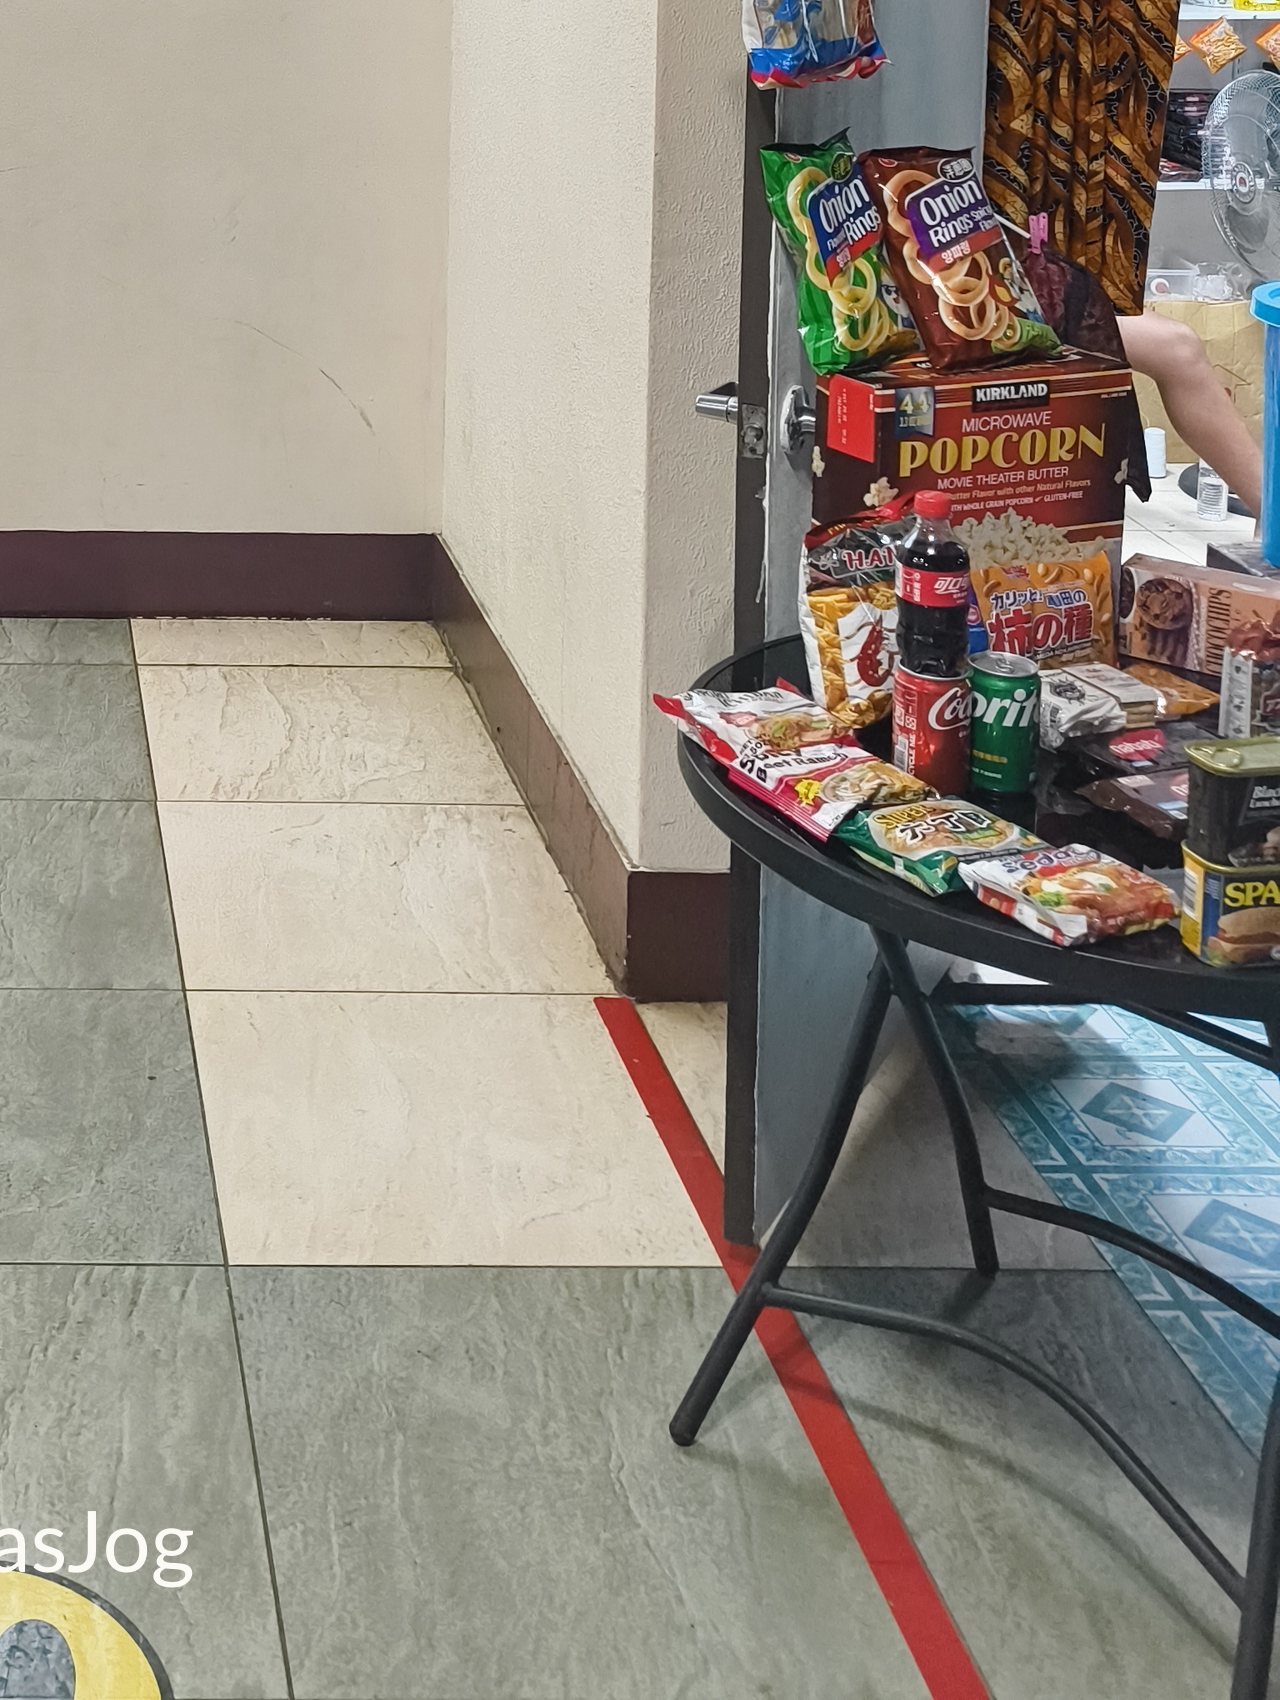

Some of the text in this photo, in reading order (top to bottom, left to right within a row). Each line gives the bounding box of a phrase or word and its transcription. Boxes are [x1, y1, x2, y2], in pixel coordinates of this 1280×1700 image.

[820, 178, 870, 234] Onion
[920, 179, 983, 227] Onion
[843, 205, 882, 246] Rings
[928, 212, 974, 248] Rings
[976, 383, 1048, 401] KIRKLAND
[962, 411, 1052, 433] MICROWAVE
[899, 422, 1106, 478] POPCORN
[937, 465, 1069, 490] MOVIE THEATER BUTTER
[1036, 481, 1064, 492] Natural
[1065, 478, 1092, 488] Flavors
[986, 603, 1093, 657] 柿の種
